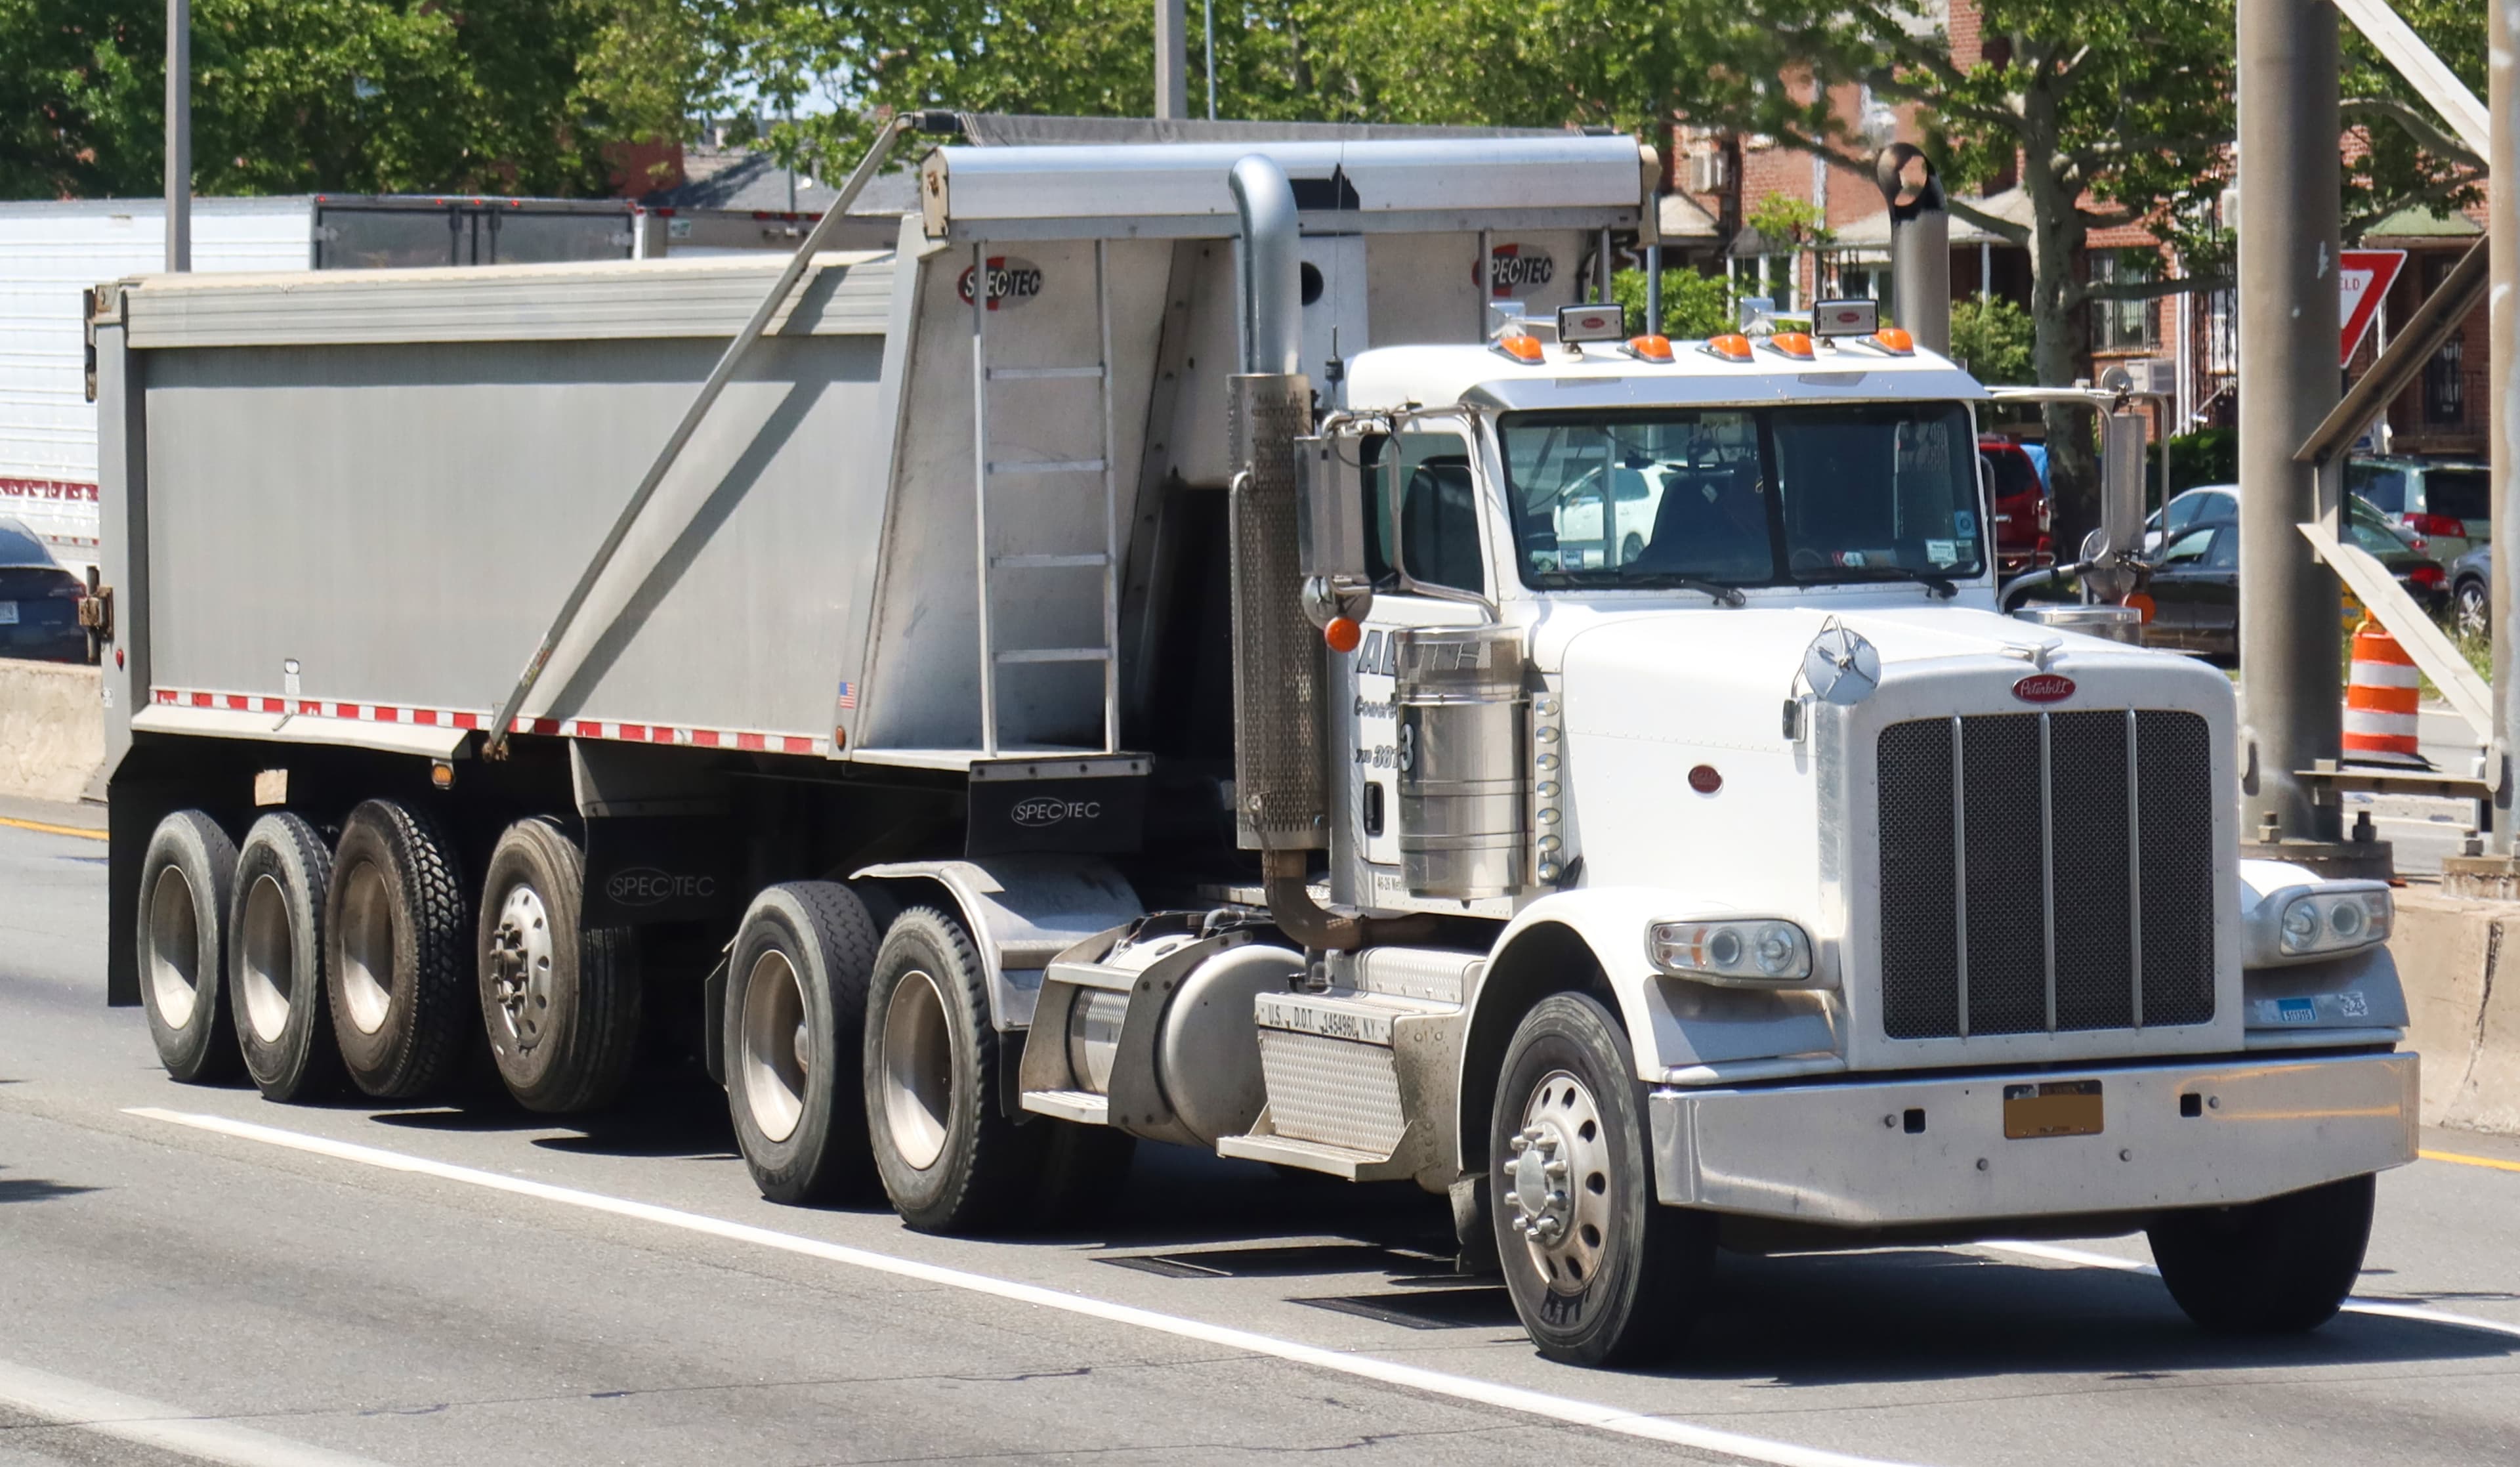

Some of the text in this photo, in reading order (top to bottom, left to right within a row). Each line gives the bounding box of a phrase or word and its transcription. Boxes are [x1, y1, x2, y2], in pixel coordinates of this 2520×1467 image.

[965, 268, 1041, 297] SECTEC
[2020, 679, 2070, 697] Peterbilt
[1268, 1004, 1283, 1026] U.S.
[1294, 1006, 1315, 1031] D.O.T.
[1362, 1018, 1377, 1040] N.Y.
